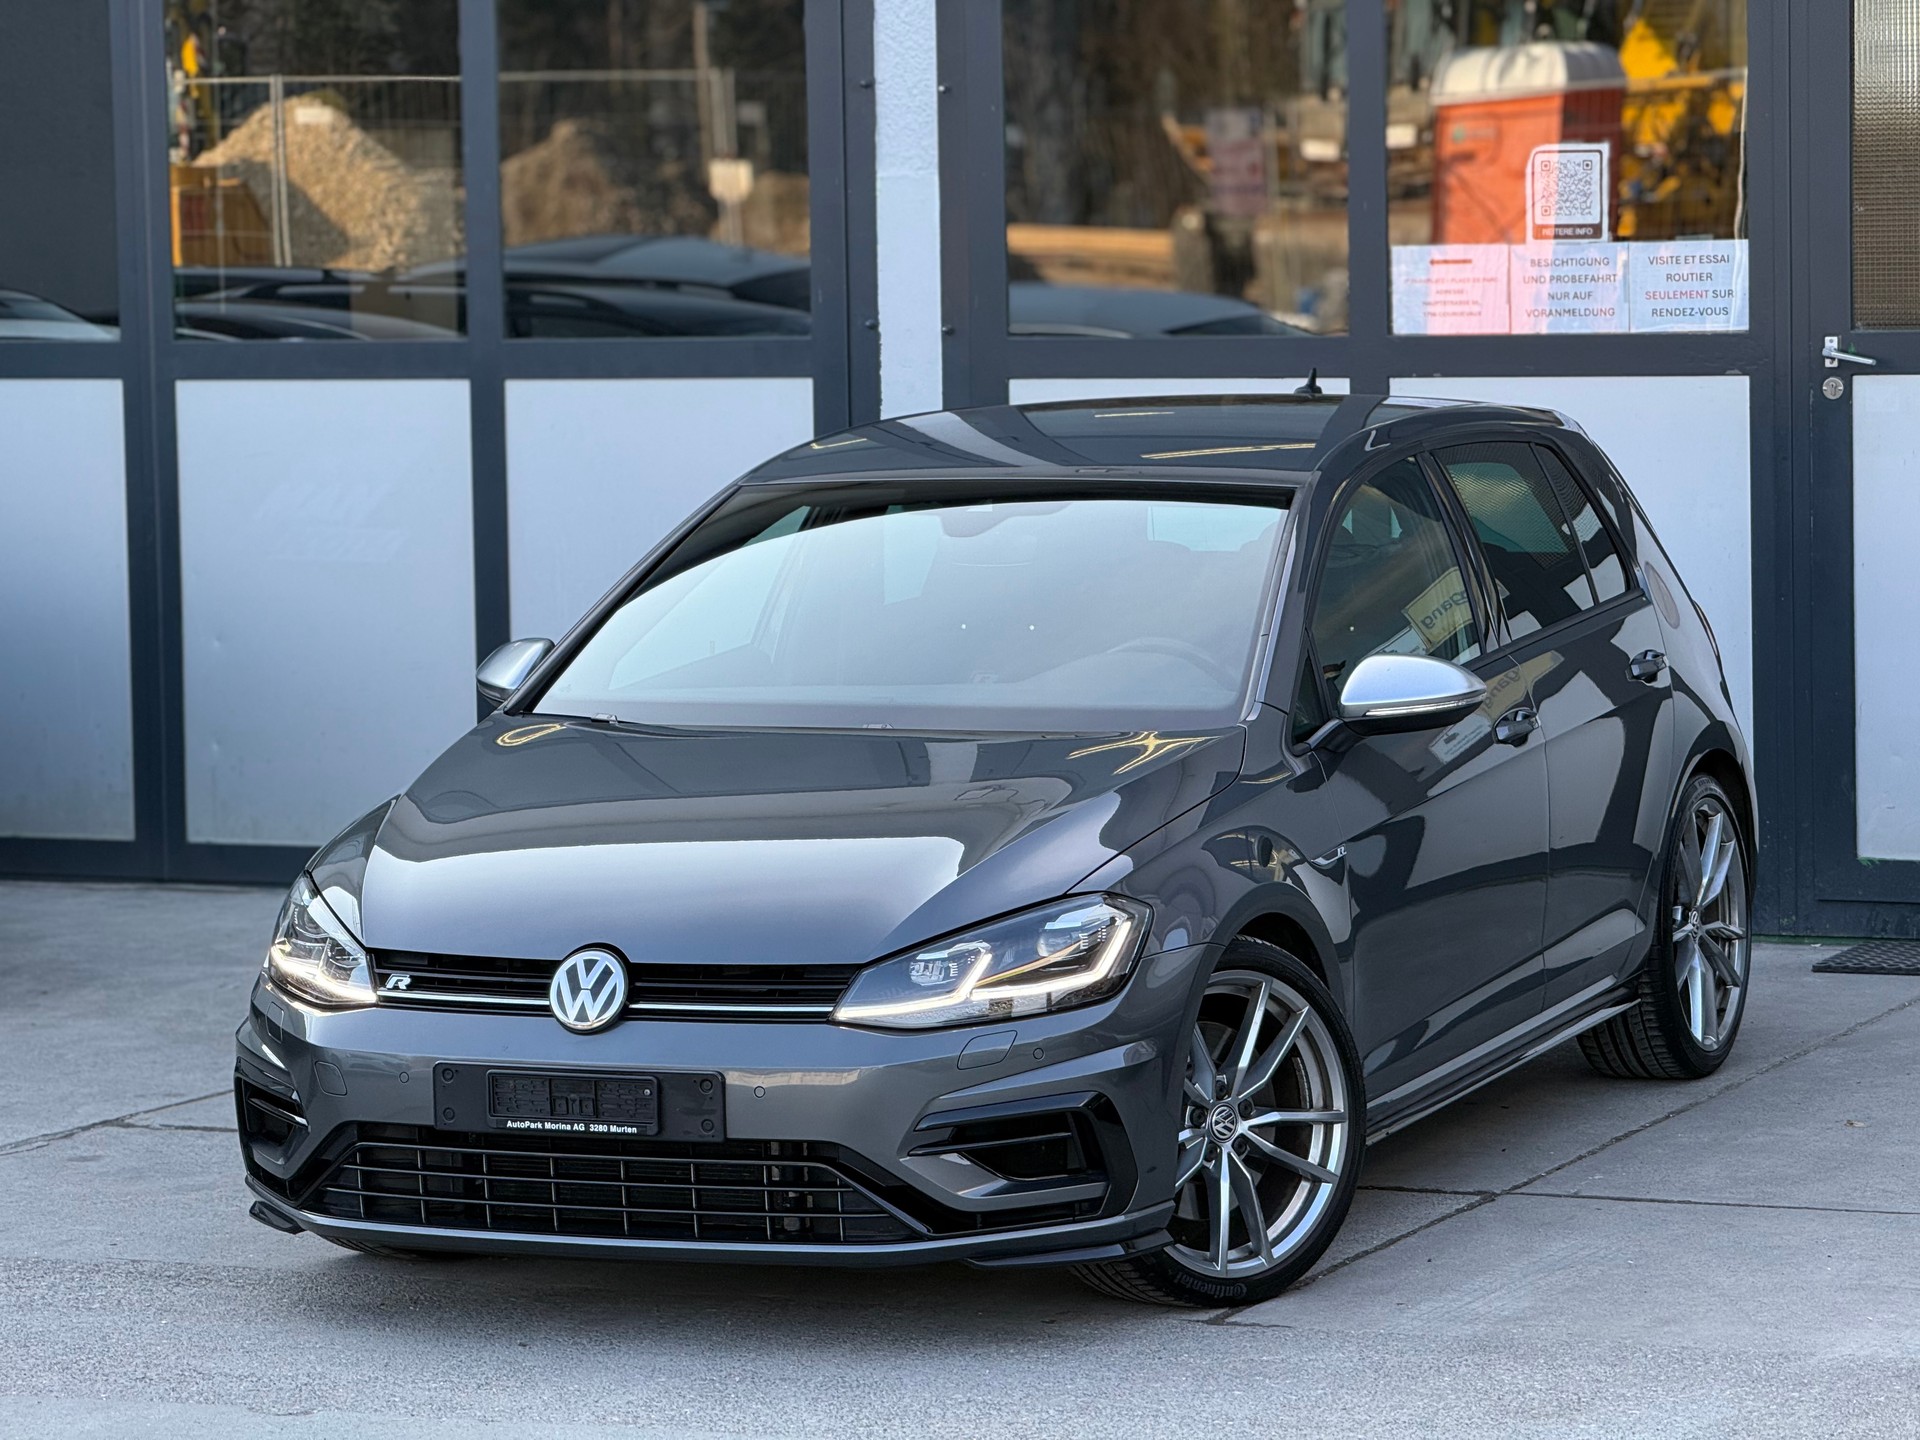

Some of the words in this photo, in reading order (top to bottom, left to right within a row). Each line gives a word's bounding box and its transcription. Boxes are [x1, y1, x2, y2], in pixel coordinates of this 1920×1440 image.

[1575, 227, 1594, 235] INFO
[1529, 257, 1610, 268] BESICHTIGUNG
[1647, 255, 1682, 265] VISITE
[1683, 255, 1697, 265] ET
[1698, 254, 1730, 264] ESSAI
[1522, 275, 1547, 284] UND
[1549, 274, 1617, 284] PROBEFAHRT
[1665, 272, 1713, 282] ROUTIER
[1547, 291, 1571, 301] NUR
[1572, 291, 1594, 300] AUF
[1644, 290, 1710, 300] SEULEMENT
[1711, 289, 1735, 299] SUR
[1525, 307, 1616, 318] VORANMELDUNG
[1651, 306, 1729, 317] RENDEZ-VOUS
[385, 973, 412, 991] R
[550, 949, 627, 1030] VW
[506, 1120, 543, 1130] AutoPark
[544, 1121, 571, 1131] Morina
[573, 1122, 586, 1132] AG
[589, 1124, 608, 1133] 3280
[610, 1125, 638, 1134] Murten
